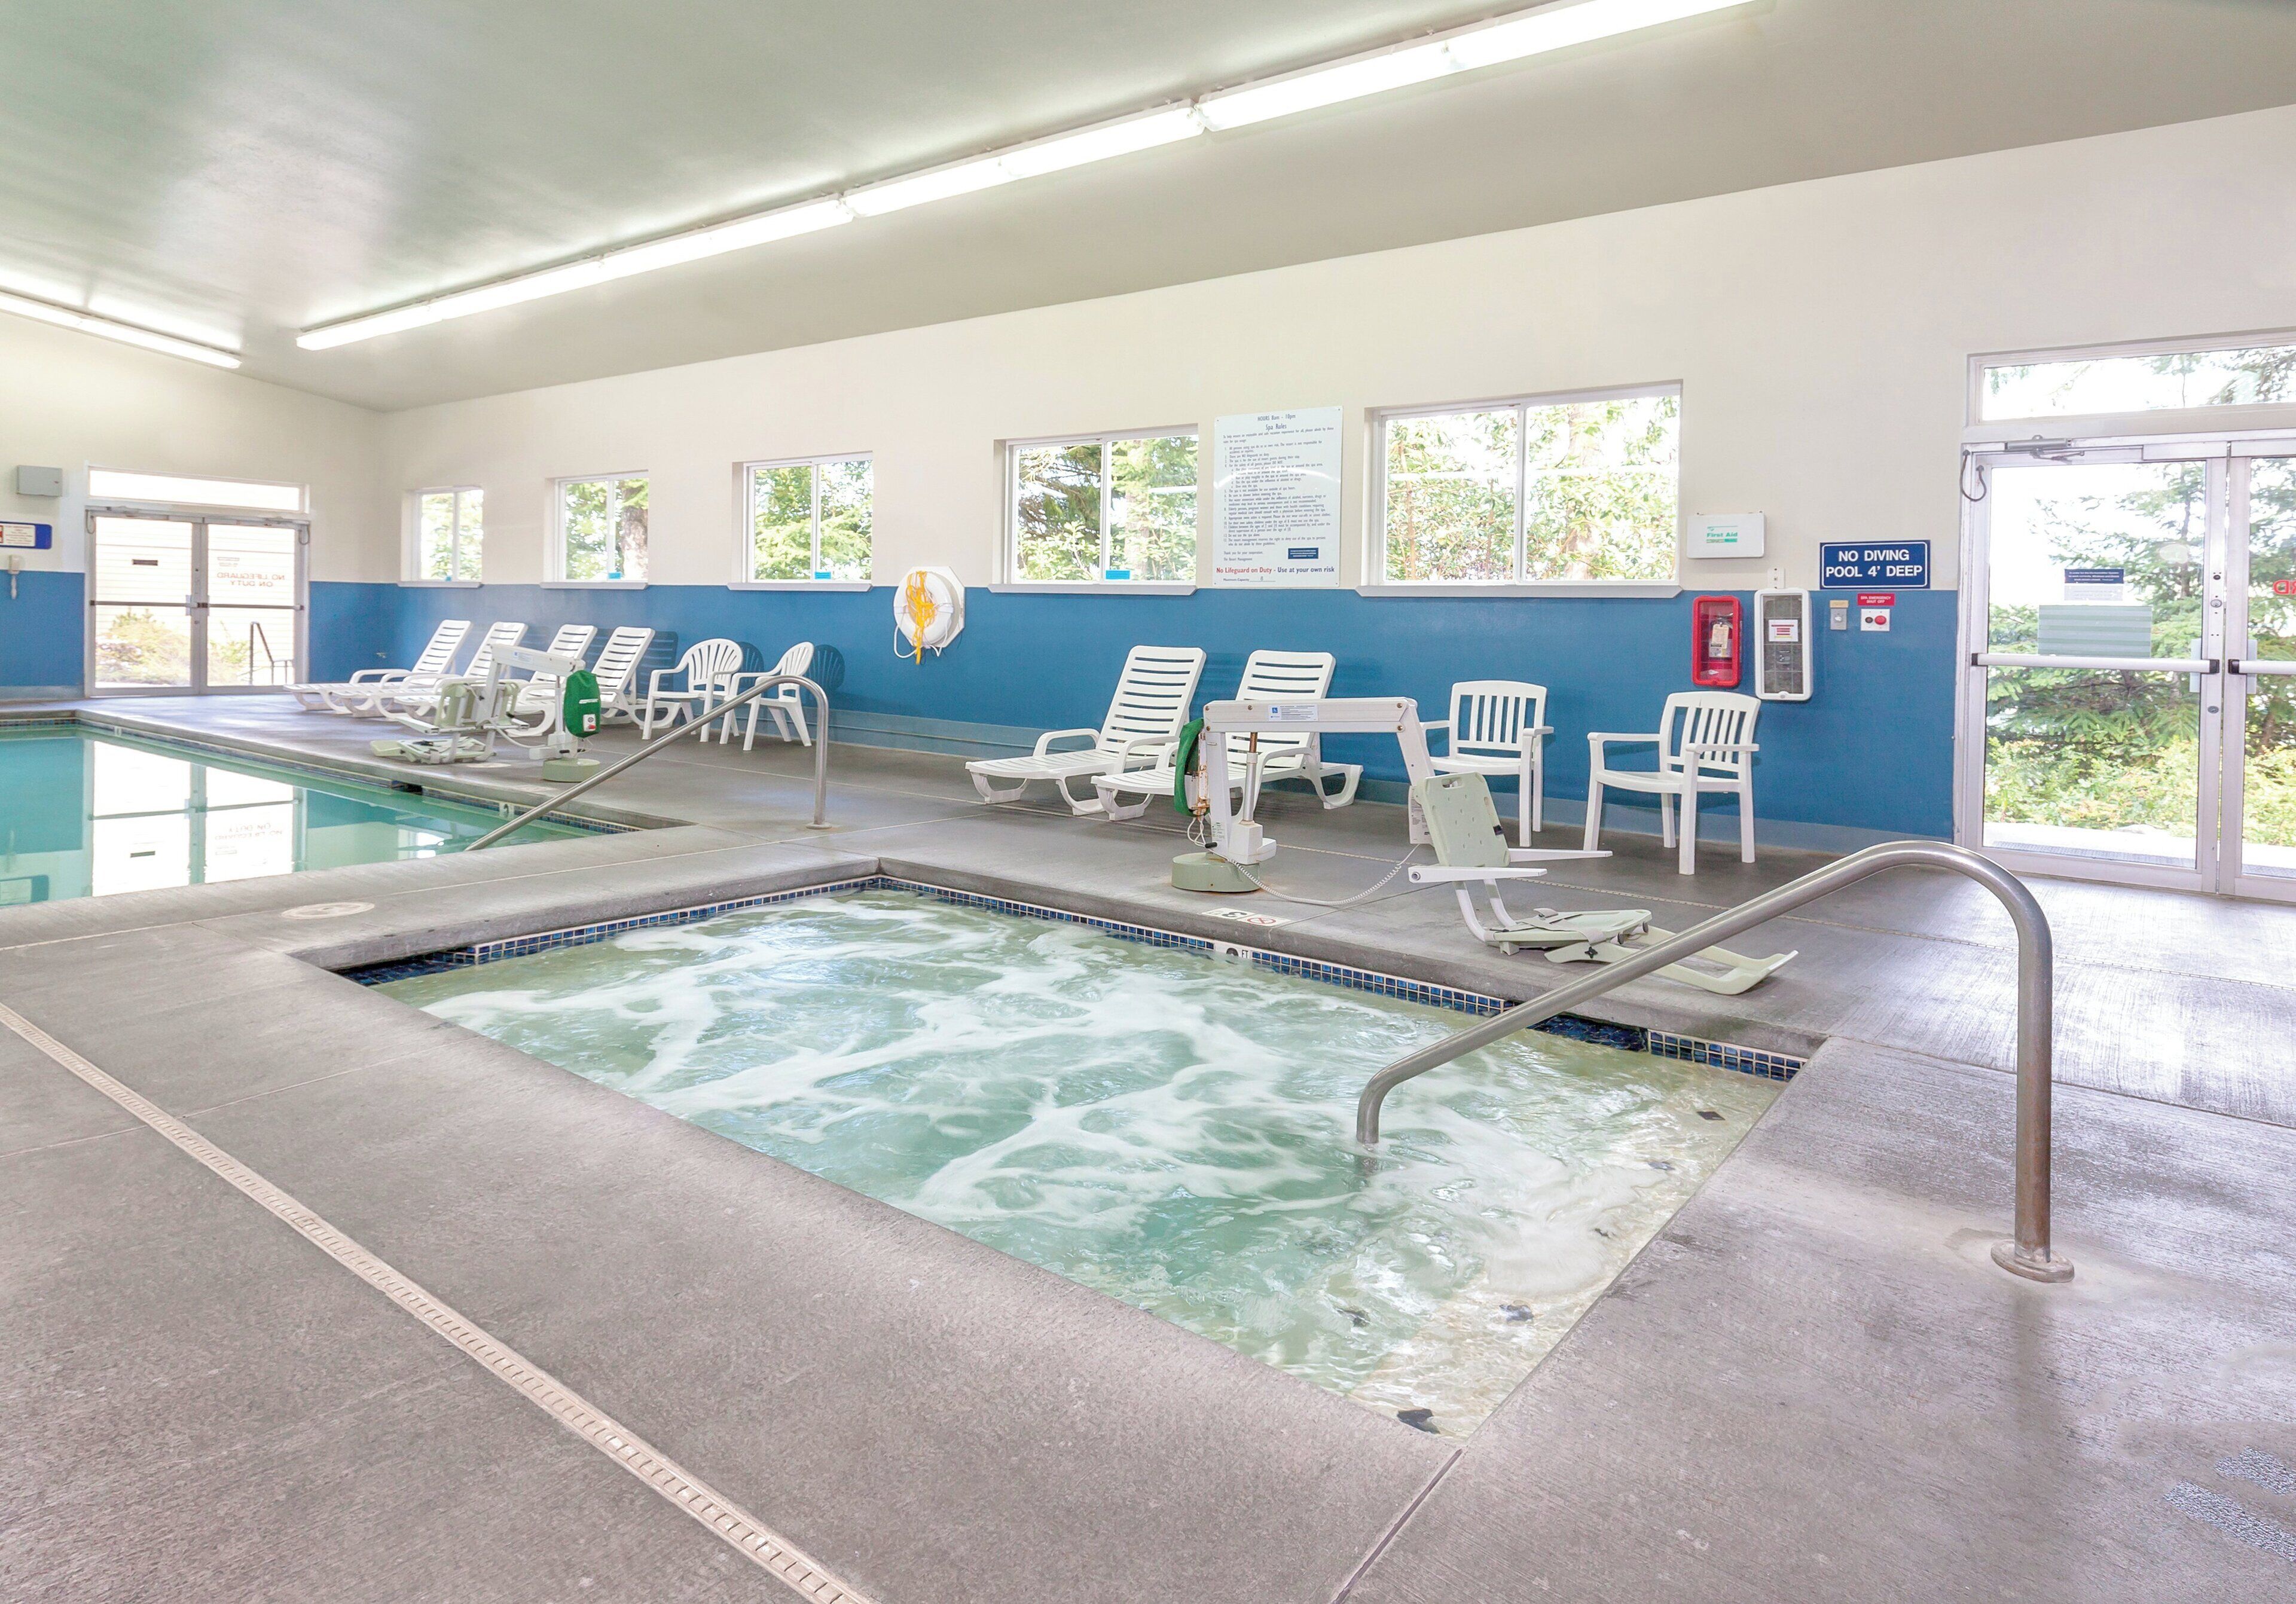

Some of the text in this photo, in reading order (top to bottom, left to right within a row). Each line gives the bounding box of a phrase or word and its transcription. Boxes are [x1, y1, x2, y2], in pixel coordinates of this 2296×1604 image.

[1839, 549, 1909, 561] NO DIVING
[1826, 565, 1923, 578] POOL 4' DEEP
